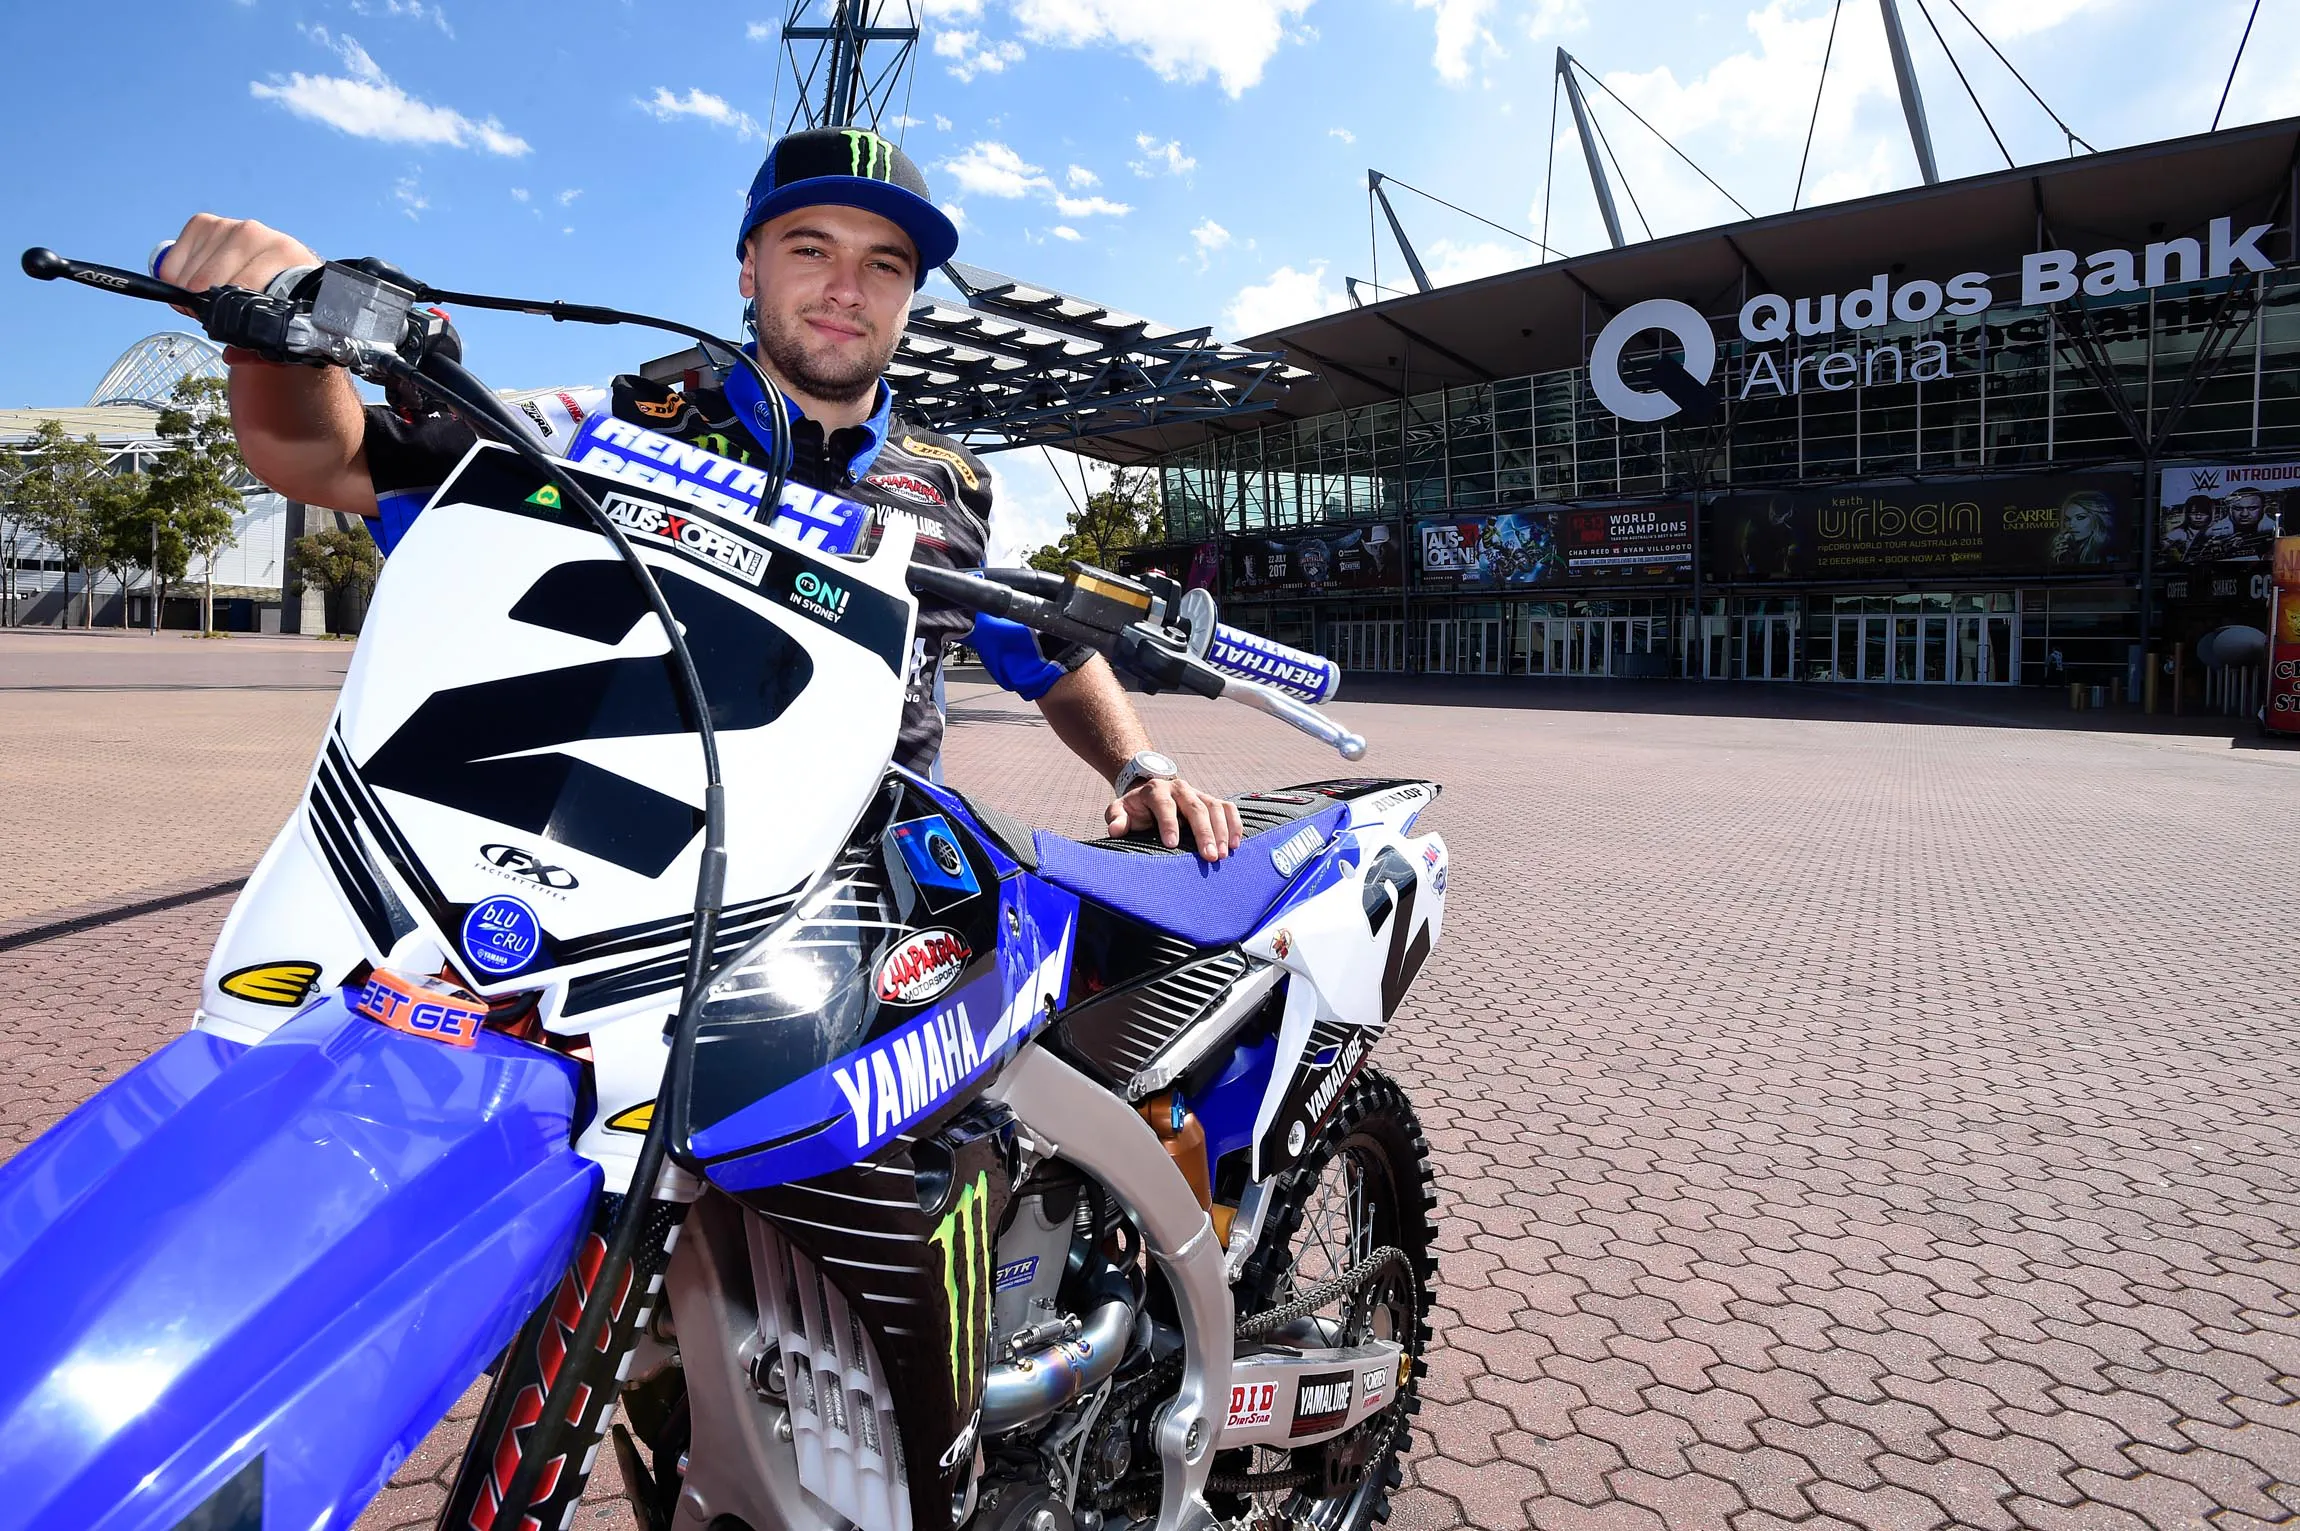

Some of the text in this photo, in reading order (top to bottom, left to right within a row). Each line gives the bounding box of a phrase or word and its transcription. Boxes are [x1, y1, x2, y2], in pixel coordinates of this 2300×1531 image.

[74, 270, 129, 288] ARC
[1738, 216, 2276, 343] Qudos Bank
[1739, 341, 1955, 401] Arena
[591, 418, 848, 527] RENTHAL
[920, 447, 975, 484] DUNLOP
[1610, 512, 1656, 524] WORLD
[1832, 496, 1863, 507] keith
[2003, 508, 2060, 523] CARRIE
[1610, 520, 1687, 535] CHAMPIONS
[1817, 498, 1981, 541] urban
[1268, 554, 1287, 564] 22 JULY
[1647, 544, 1692, 552] VILLOPOTO
[1817, 557, 1828, 566] 12
[1829, 556, 1876, 566] DECEMBER
[1885, 555, 1909, 564] BOOK
[1911, 554, 1933, 563] NOW
[1934, 554, 1947, 562] AT
[1852, 542, 1882, 550] WORLD
[1884, 541, 1909, 549] TOUR
[1910, 539, 1959, 549] AUSTRALIA
[1960, 538, 1984, 546] 2016
[801, 579, 815, 590] IT'S
[1268, 564, 1287, 577] 2017
[789, 592, 842, 624] IN SYDNEY
[795, 571, 851, 615] ON!
[1214, 641, 1324, 690] RENTHAL
[1373, 788, 1423, 812] DUNLOP
[1283, 825, 1326, 866] YAMAHA
[475, 863, 568, 902] FACTORY EFFEX
[494, 848, 564, 886] FX
[483, 950, 509, 965] YAMAHA
[876, 933, 973, 1000] CHAPARRAL
[905, 964, 962, 1003] MOTORSPORTS
[411, 1004, 488, 1038] GET
[832, 1001, 980, 1149] YAMAHA
[1305, 1030, 1364, 1123] YAMALUBE
[1300, 1381, 1351, 1416] YAMALUBE
